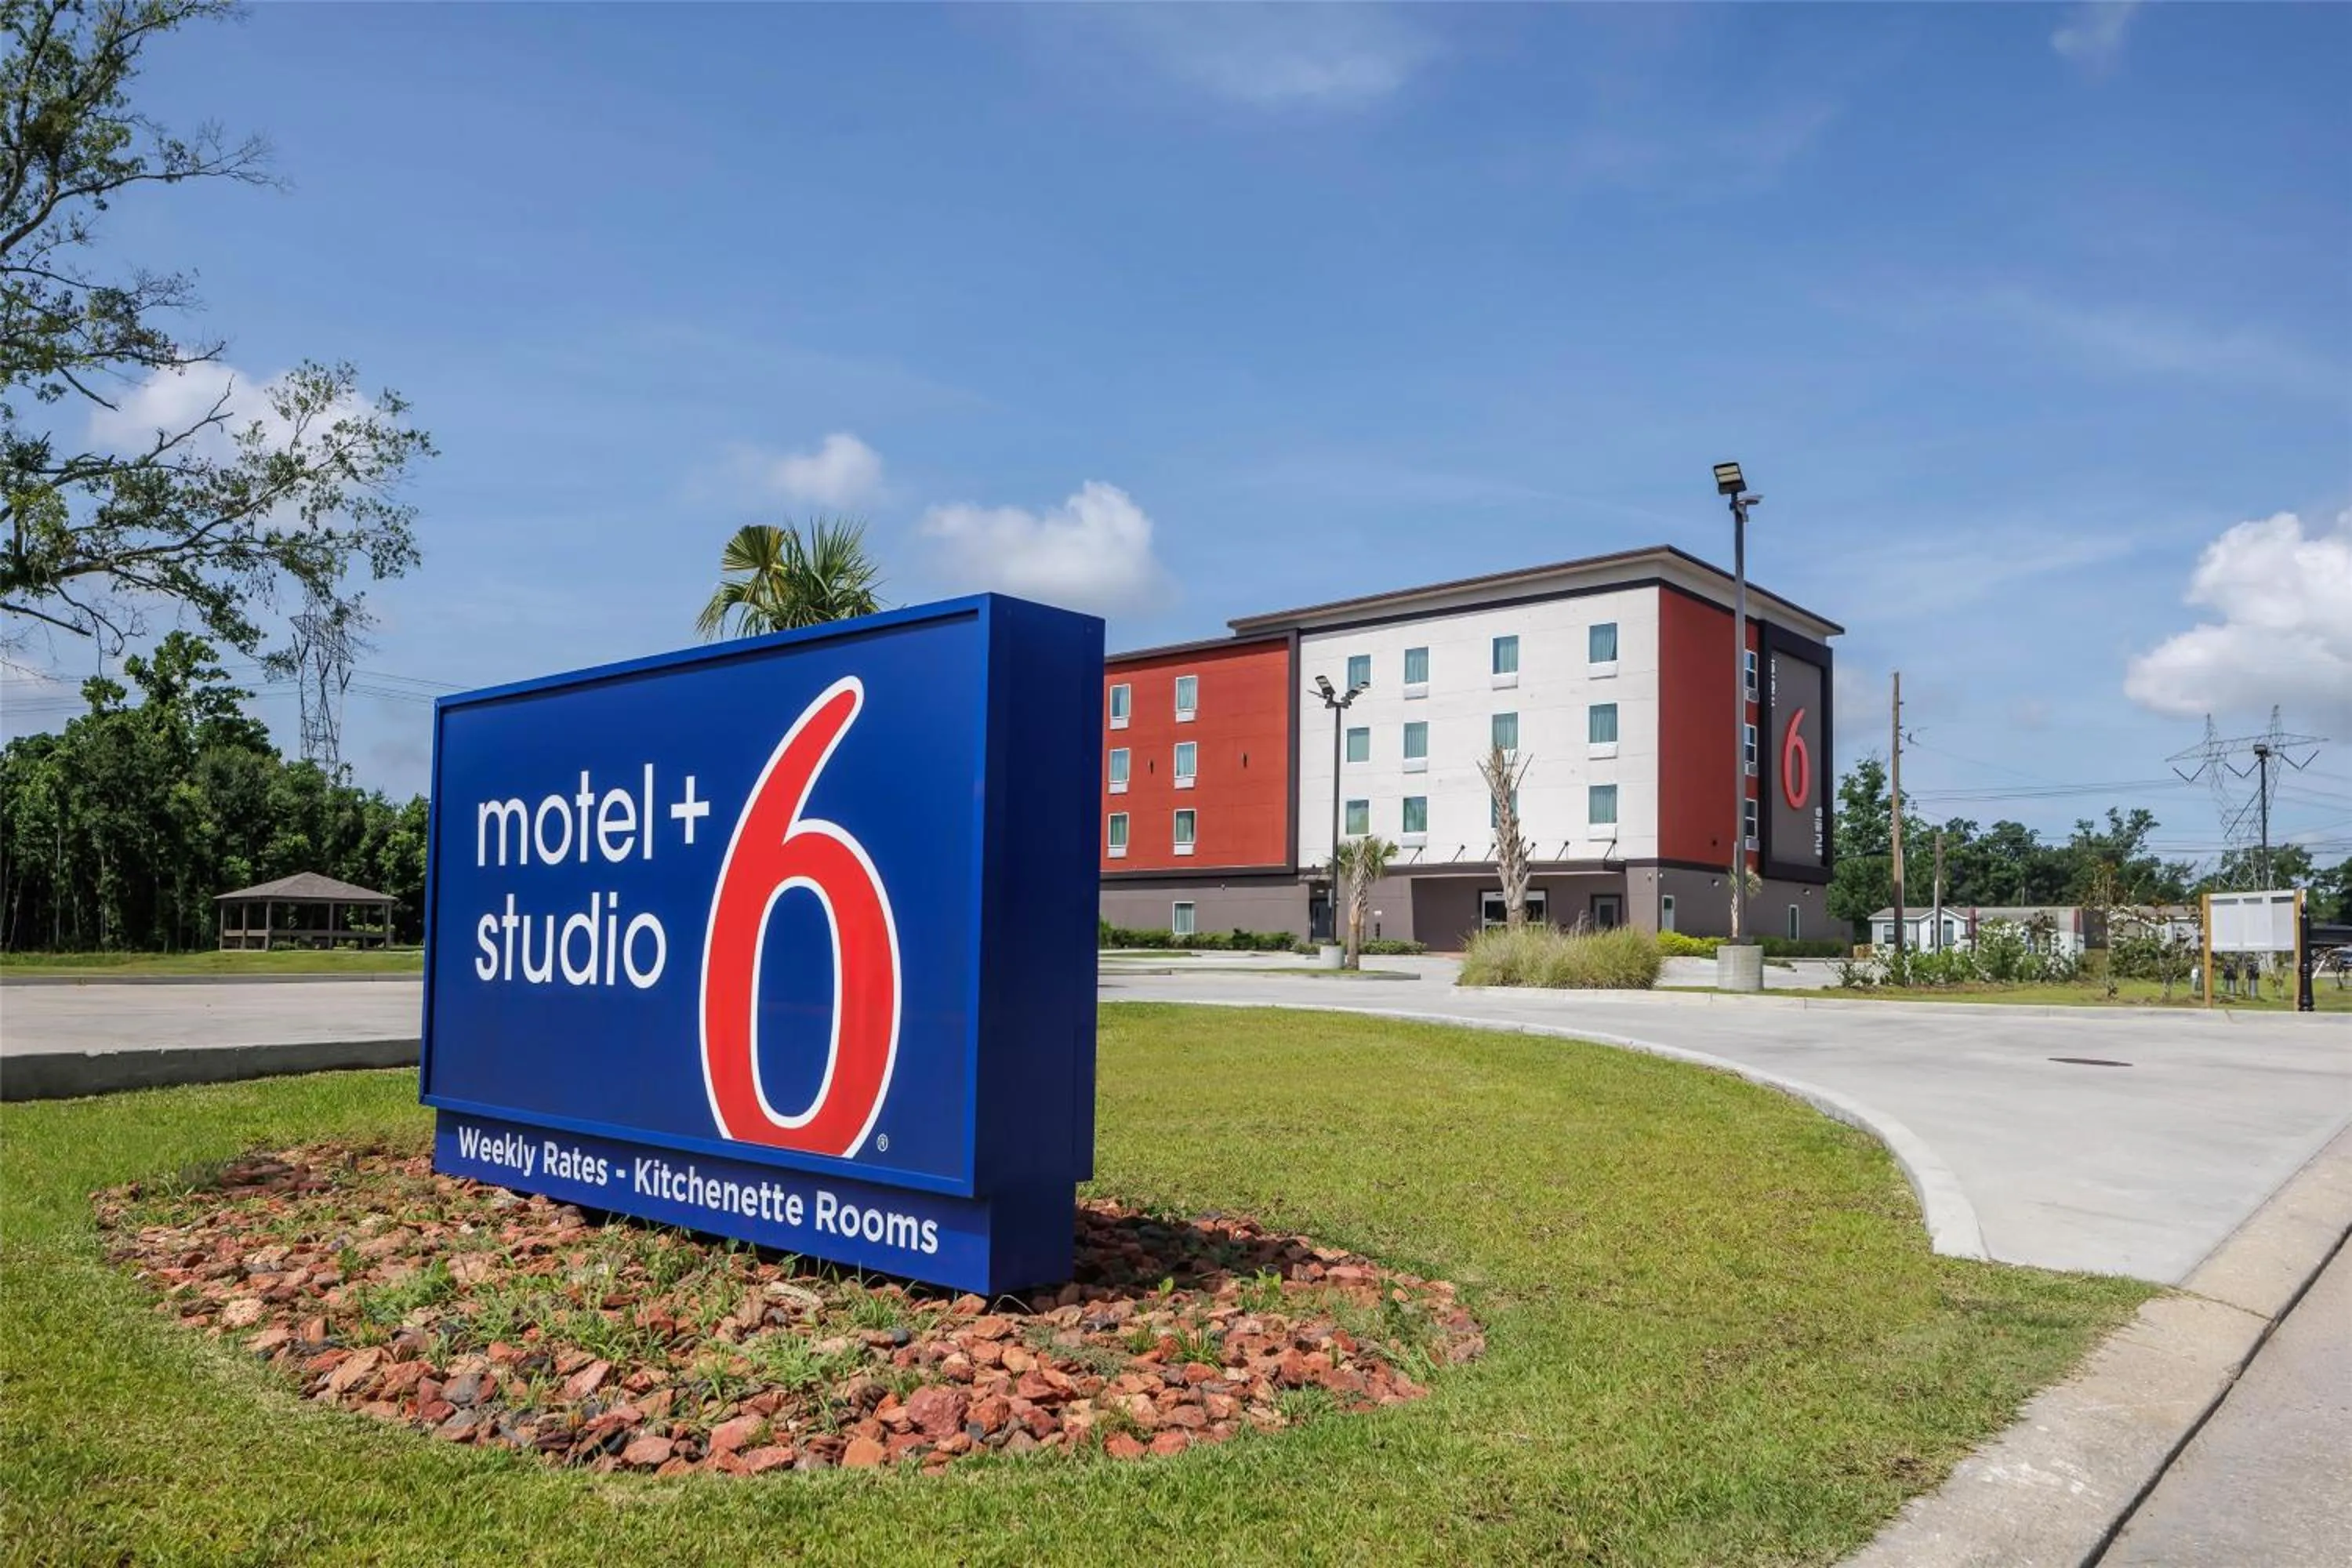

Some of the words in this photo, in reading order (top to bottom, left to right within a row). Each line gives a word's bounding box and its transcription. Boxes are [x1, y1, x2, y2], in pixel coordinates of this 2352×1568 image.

[1782, 707, 1809, 810] 6
[477, 763, 653, 866] motel
[475, 891, 666, 989] studio
[699, 675, 902, 1160] 6
[458, 1126, 536, 1177] Weekly
[543, 1141, 608, 1186] Rates
[634, 1157, 804, 1226] Kitchenette
[815, 1190, 938, 1254] Rooms
